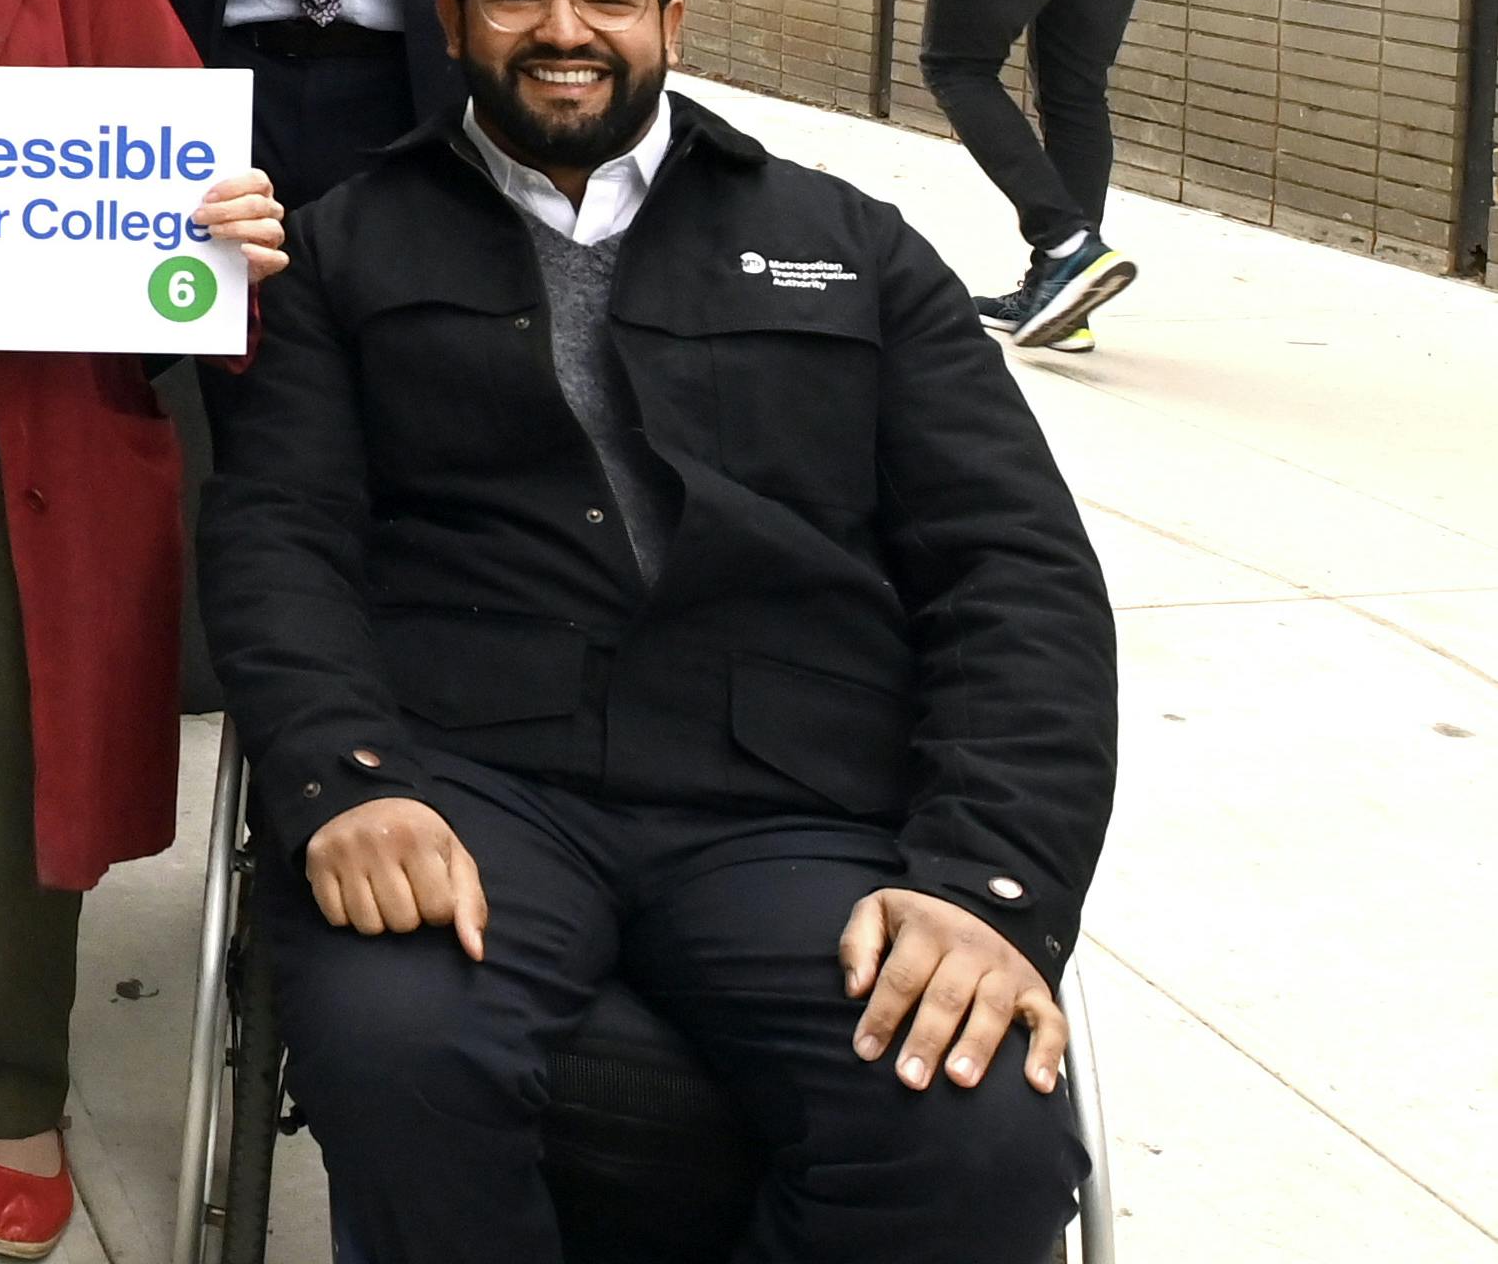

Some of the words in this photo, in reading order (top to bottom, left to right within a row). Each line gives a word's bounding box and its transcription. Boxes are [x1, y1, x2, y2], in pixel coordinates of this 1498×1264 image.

[769, 260, 842, 273] Metropolitan
[770, 269, 857, 280] Transportation
[168, 270, 196, 307] 6
[773, 277, 826, 291] Authority
